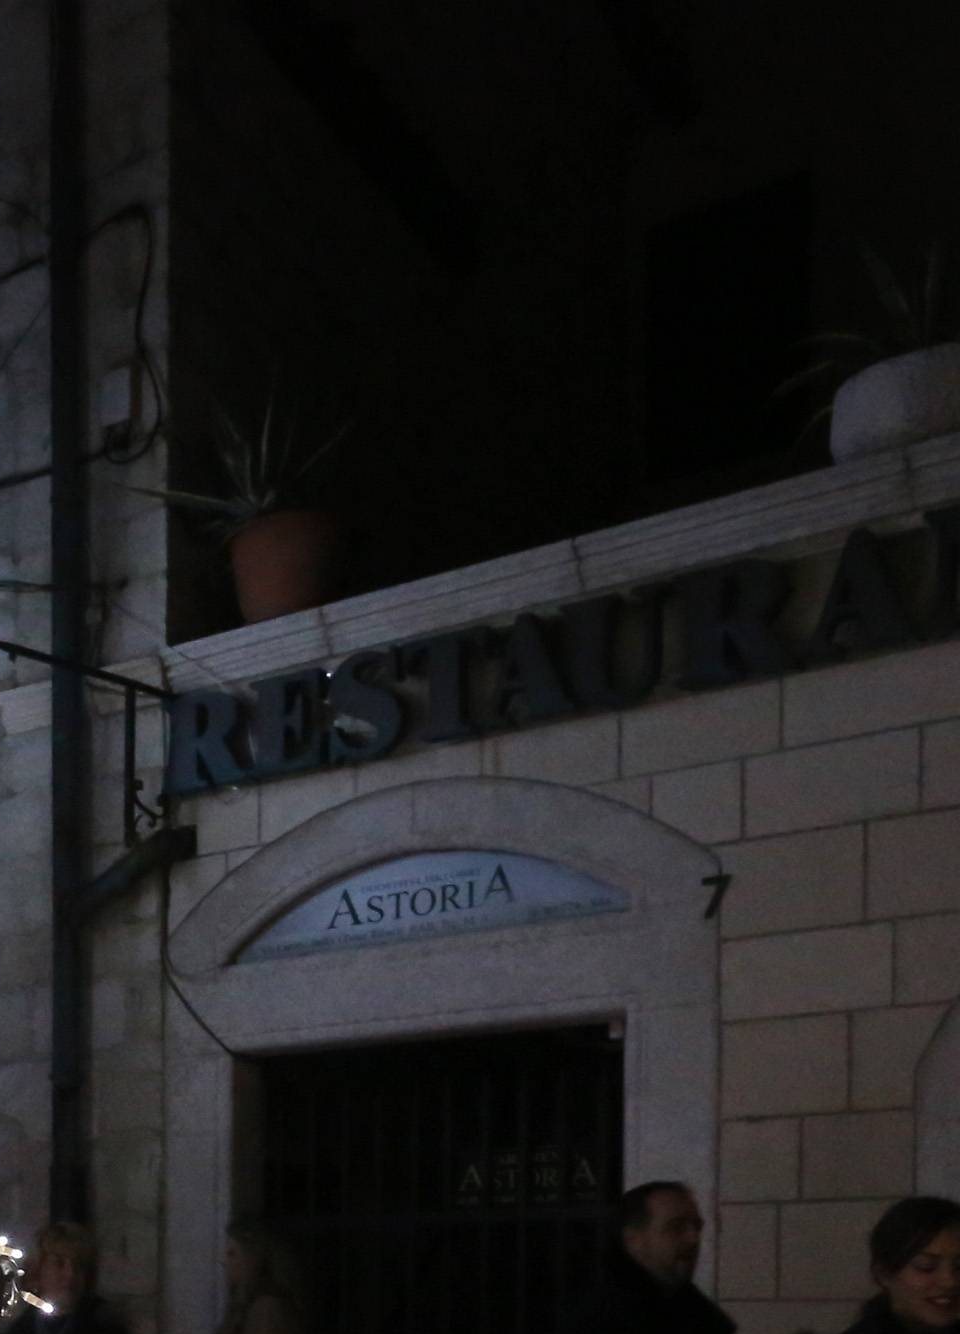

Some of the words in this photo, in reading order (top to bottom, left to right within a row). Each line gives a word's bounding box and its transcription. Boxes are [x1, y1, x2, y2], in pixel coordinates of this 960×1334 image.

[327, 864, 513, 930] ASTORIA
[702, 874, 731, 919] 7
[457, 1156, 600, 1192] ASTRA
